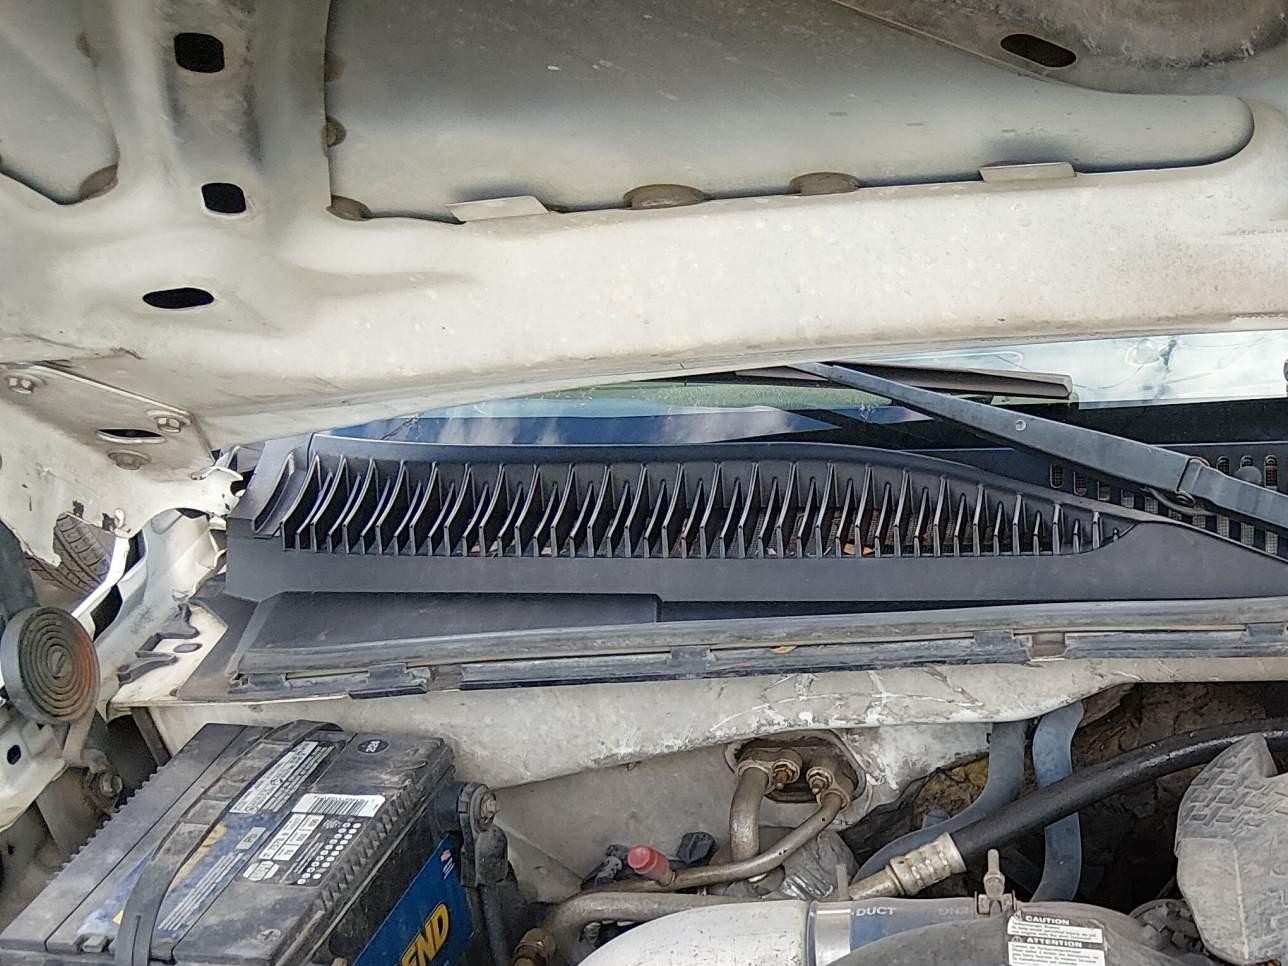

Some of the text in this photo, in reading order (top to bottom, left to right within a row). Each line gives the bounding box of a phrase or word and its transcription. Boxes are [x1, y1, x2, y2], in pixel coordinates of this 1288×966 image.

[855, 906, 897, 917] DUCT
[1025, 915, 1070, 926] CAUTION
[1026, 937, 1083, 948] ATTENTION
